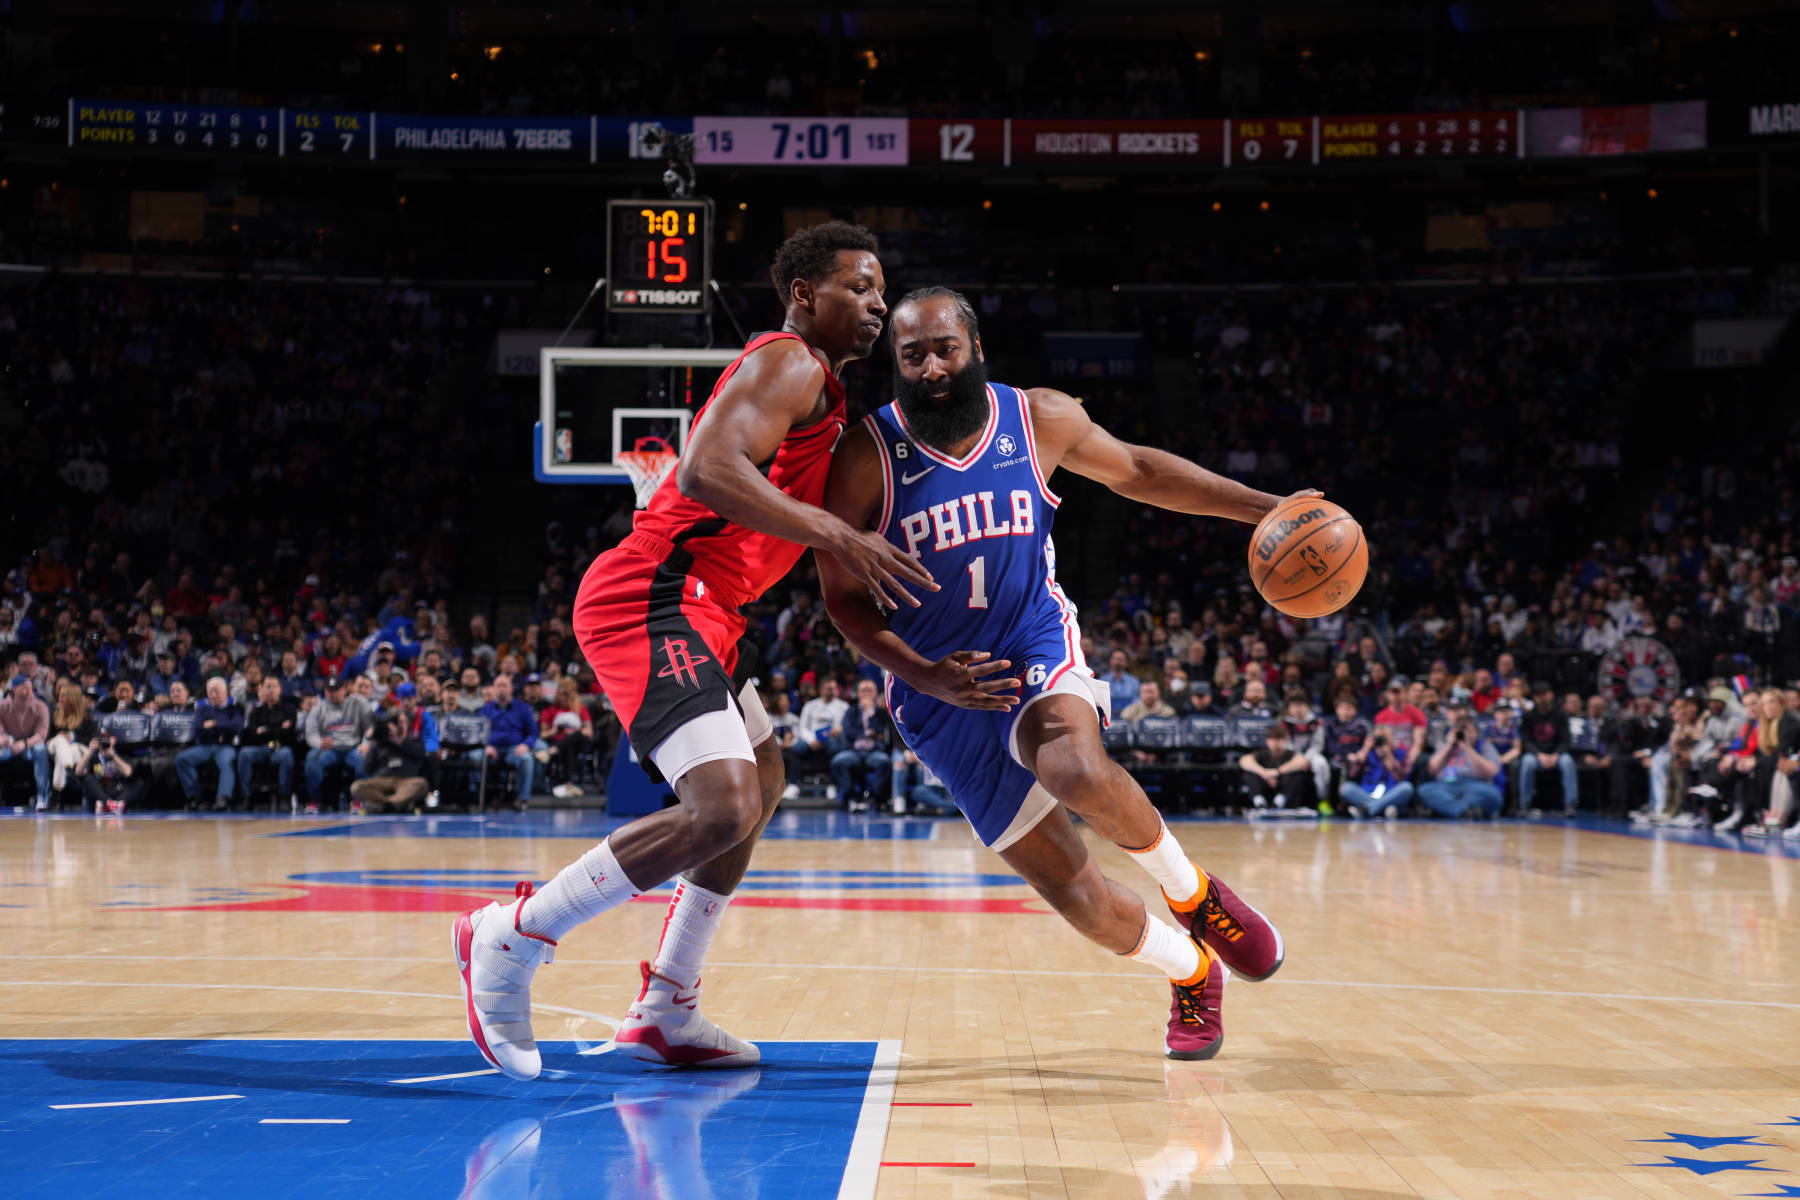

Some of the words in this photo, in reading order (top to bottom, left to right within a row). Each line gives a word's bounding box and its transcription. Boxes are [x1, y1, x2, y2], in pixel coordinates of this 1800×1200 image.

[80, 107, 135, 123] PLAYER
[144, 110, 161, 126] 12
[172, 111, 188, 126] 17
[199, 112, 216, 128] 21
[258, 115, 267, 131] 1
[296, 113, 320, 129] FLS
[334, 115, 360, 131] TOL
[1239, 122, 1265, 137] FLS
[1323, 122, 1379, 138] PLAYER
[1417, 120, 1427, 136] 1
[80, 126, 136, 143] POINTS
[147, 128, 159, 145] 3
[173, 129, 187, 146] 0
[202, 131, 215, 147] 4
[230, 132, 241, 148] 3
[256, 133, 268, 149] 0
[300, 131, 315, 152] 2
[339, 133, 354, 153] 7
[394, 127, 507, 149] PHILADELPHIA
[512, 127, 573, 150] 76ERS
[709, 131, 733, 152] 15
[771, 123, 851, 159] 7:01
[866, 133, 897, 150] 1ST
[939, 123, 976, 162] 12
[1035, 132, 1113, 154] HOUSTON
[1117, 132, 1200, 154] ROCKETS
[1243, 139, 1262, 161] 0
[1283, 139, 1299, 160] 7
[1323, 141, 1378, 157] POINTS
[641, 209, 696, 237] 7:01
[648, 238, 687, 283] 15
[896, 442, 908, 459] 6
[993, 455, 1029, 470] crypto.com
[901, 490, 1034, 560] PHILA
[1256, 507, 1328, 561] Wilson
[968, 555, 988, 609] 1
[1026, 664, 1047, 686] 6
